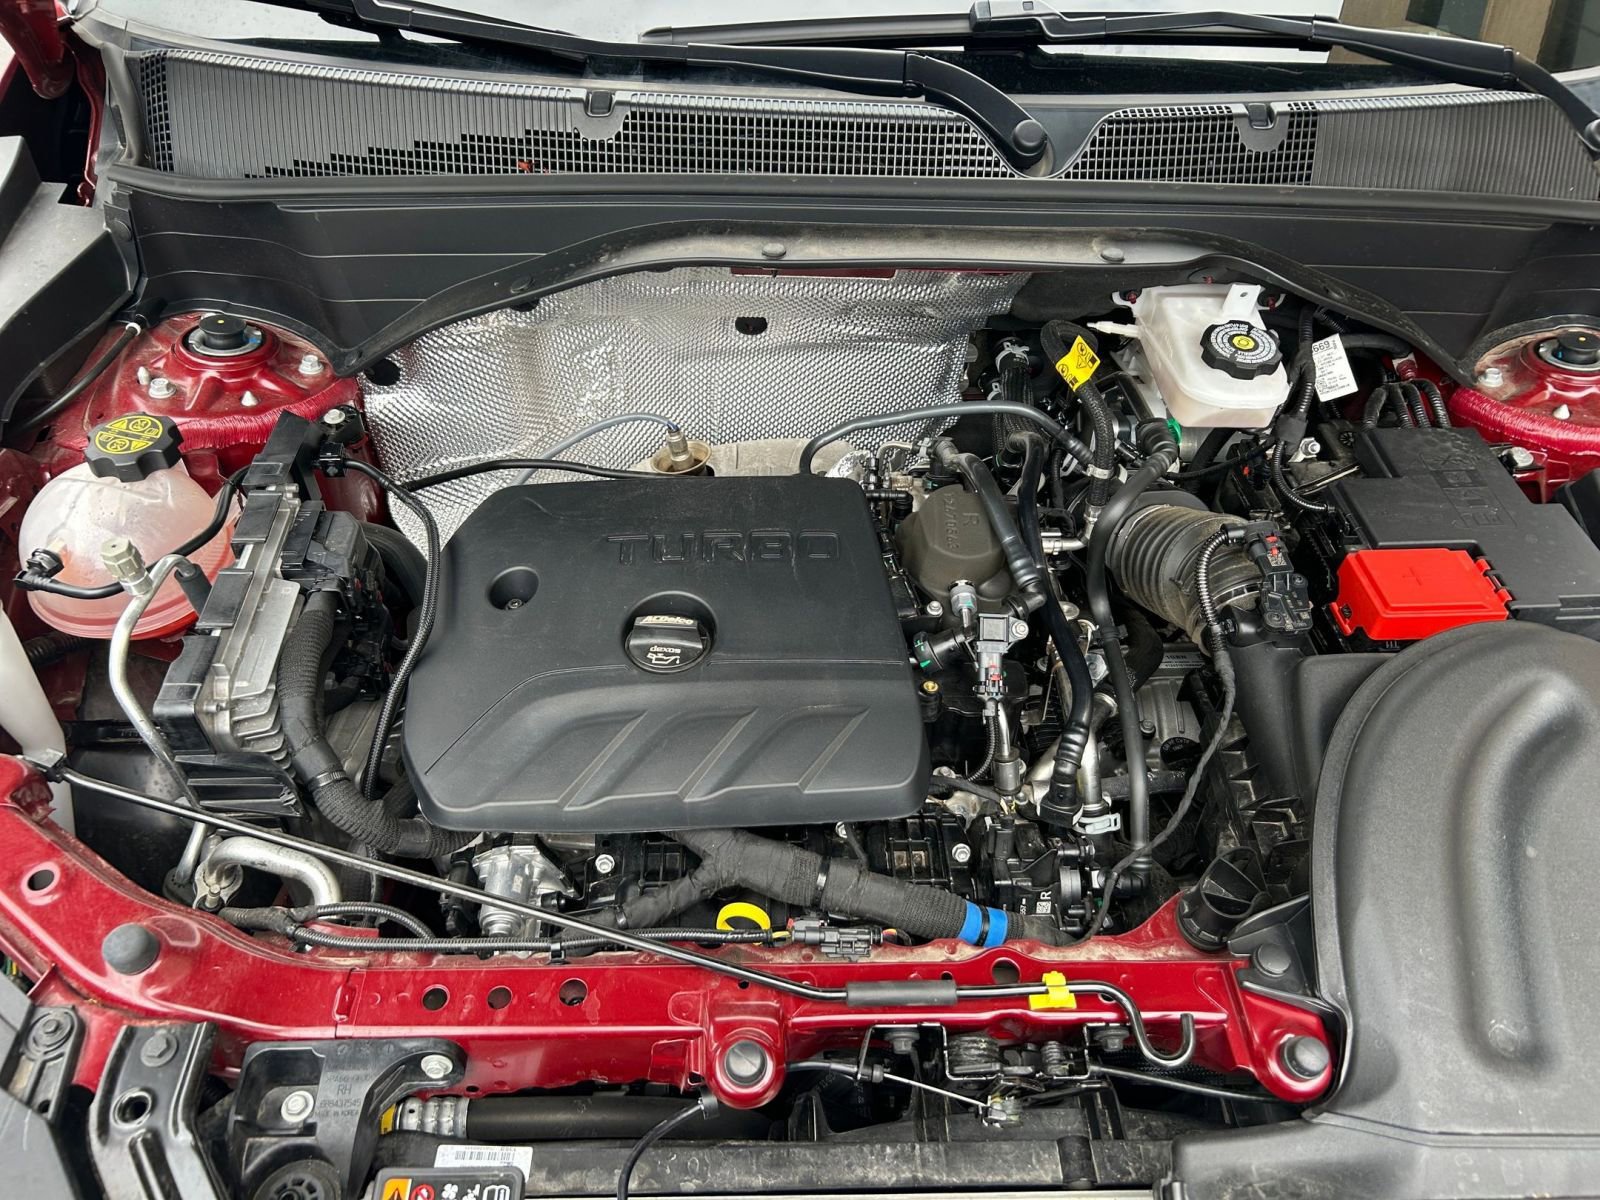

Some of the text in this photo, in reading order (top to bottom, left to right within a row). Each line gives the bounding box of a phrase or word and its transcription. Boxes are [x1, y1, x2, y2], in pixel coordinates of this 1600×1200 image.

[606, 527, 841, 565] TURBO
[649, 645, 682, 654] dexos
[337, 1083, 353, 1095] RH
